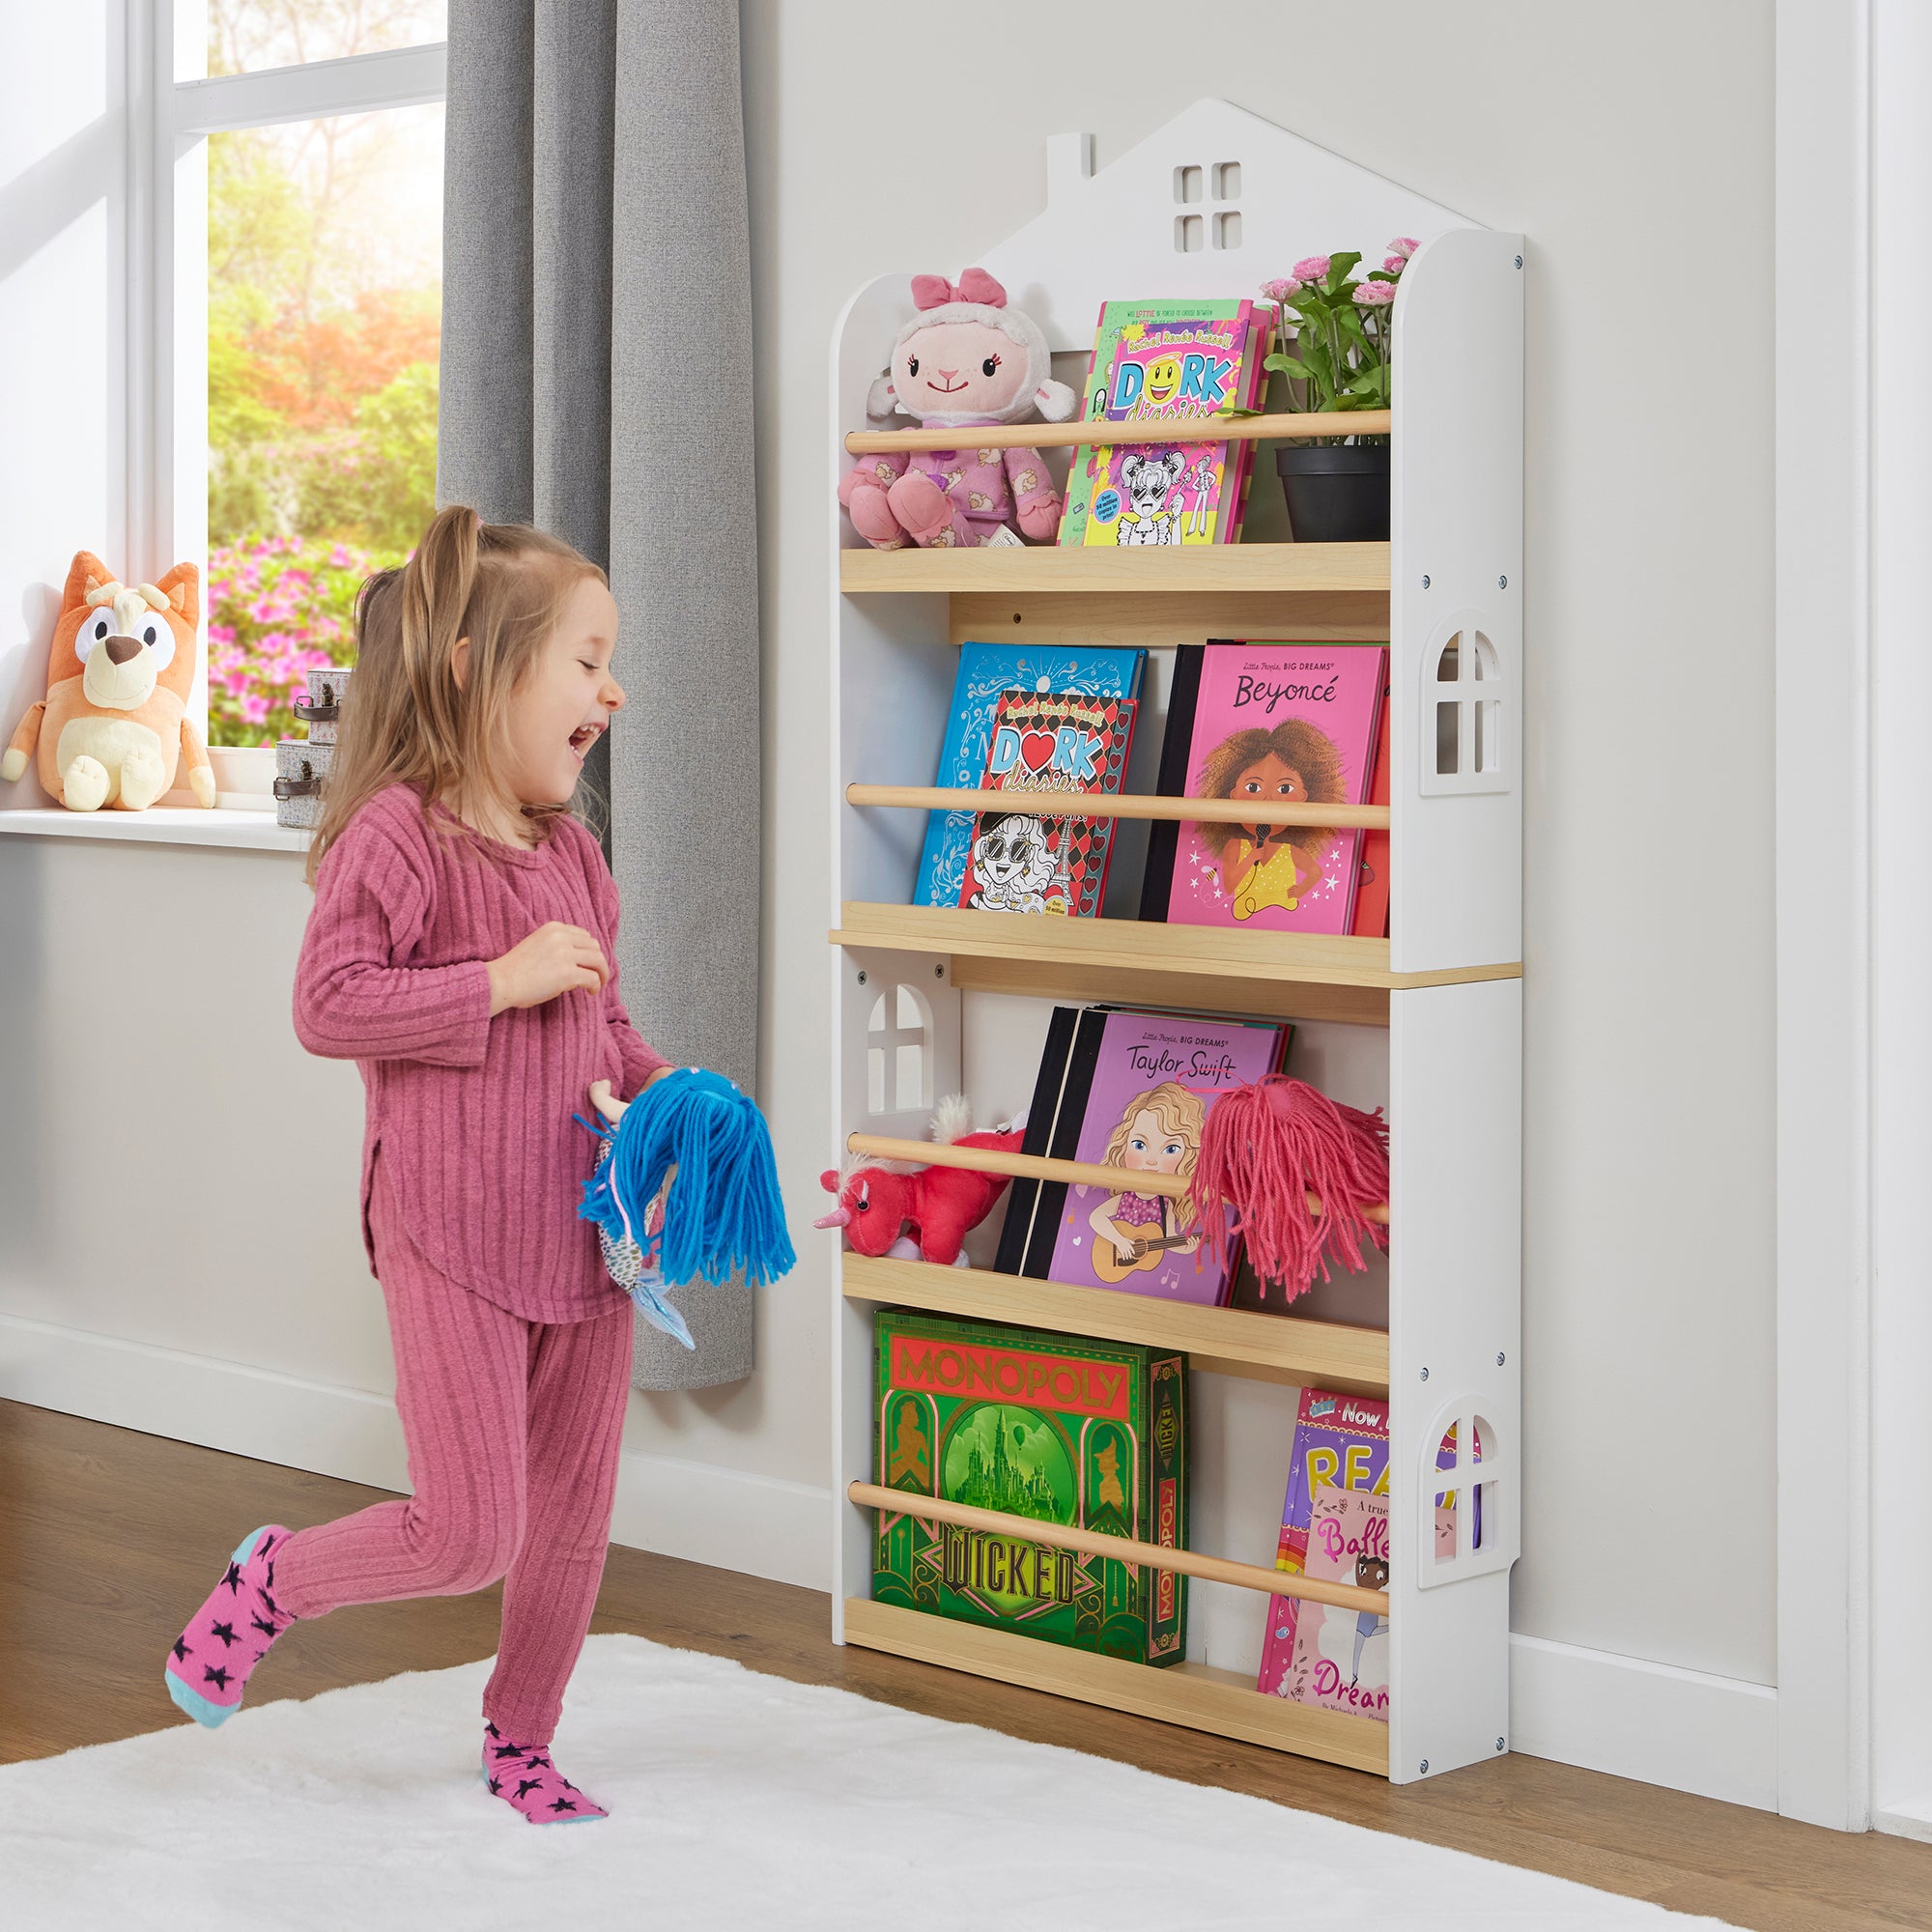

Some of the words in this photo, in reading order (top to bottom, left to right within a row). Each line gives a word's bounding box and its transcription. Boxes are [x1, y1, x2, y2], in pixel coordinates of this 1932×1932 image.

[1196, 330, 1233, 349] Russell
[1233, 675, 1339, 714] Beyoncé
[1002, 760, 1084, 792] diaries
[1179, 1036, 1193, 1044] BIG
[1126, 1045, 1184, 1079] Taylor
[1187, 1051, 1236, 1086] Swift
[898, 1344, 1122, 1409] MONOPOLY
[1342, 1403, 1380, 1427] Now
[1357, 1500, 1365, 1512] A
[1368, 1503, 1389, 1516] true
[942, 1522, 1075, 1605] WICKED
